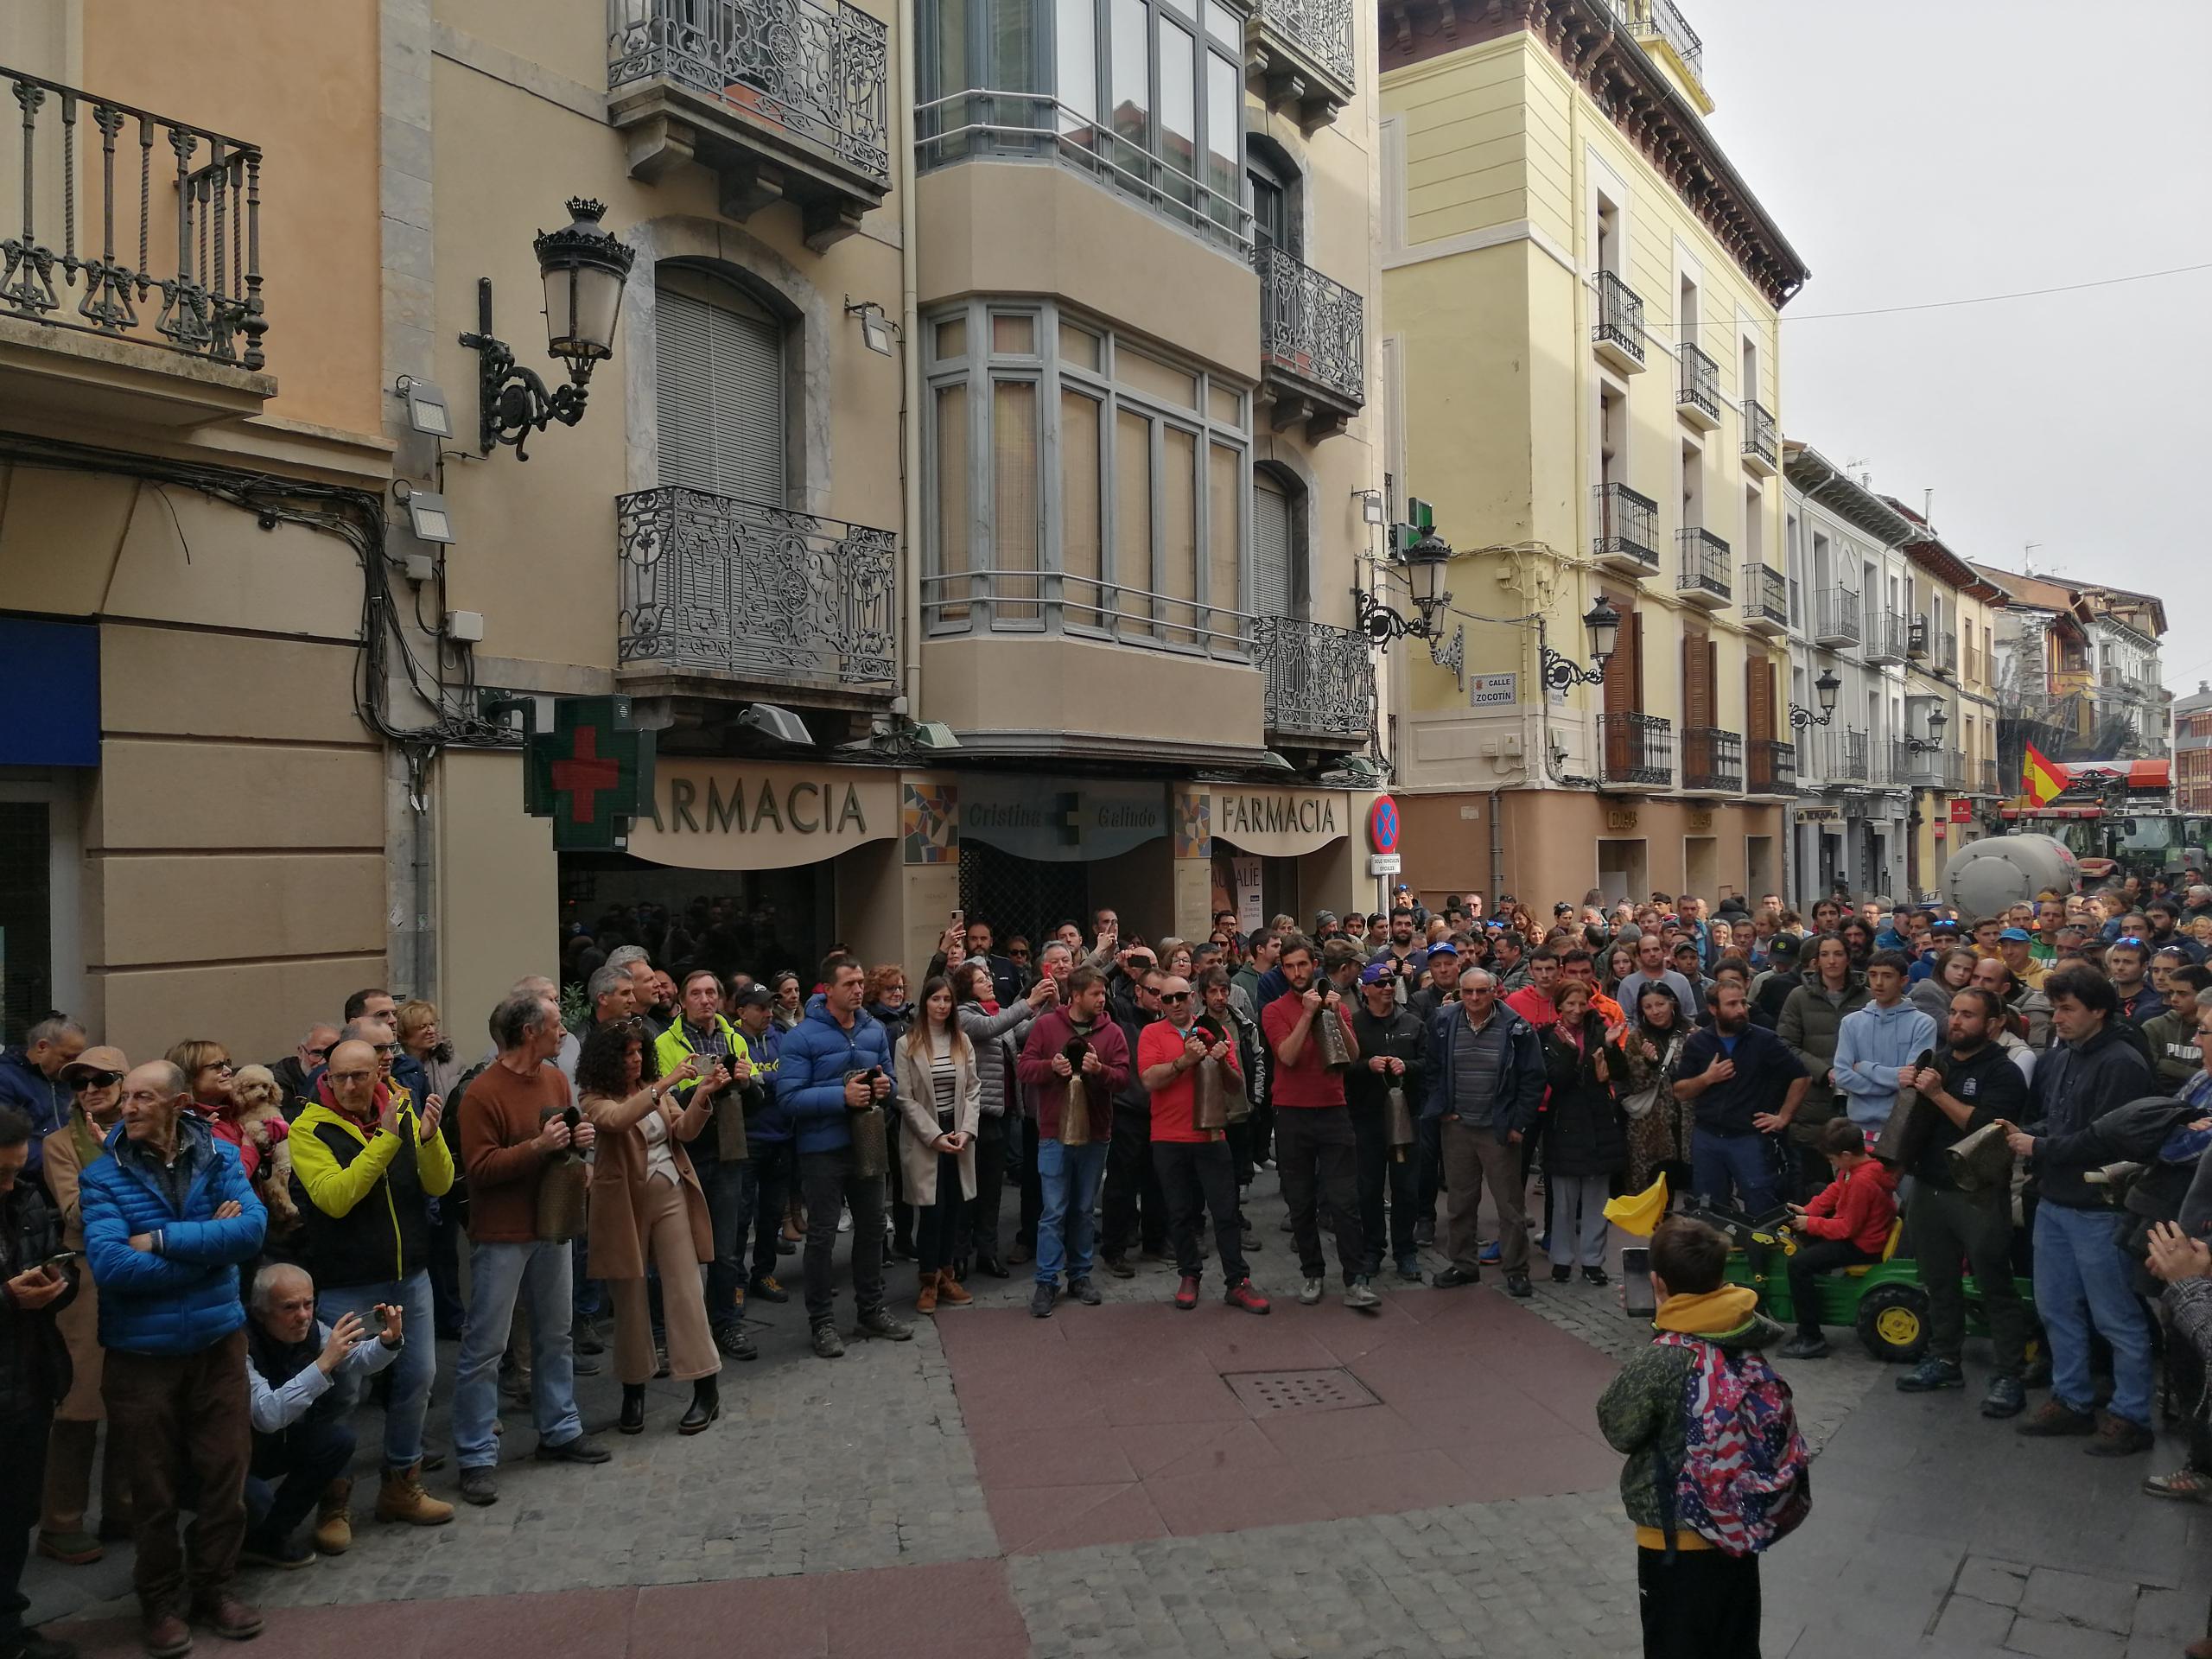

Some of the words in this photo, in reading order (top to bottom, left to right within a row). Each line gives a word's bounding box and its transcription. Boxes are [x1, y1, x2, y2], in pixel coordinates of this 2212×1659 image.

[1476, 690, 1511, 702] ZOCOTÍN
[1489, 678, 1510, 687] CALLE
[629, 777, 867, 833] RMACIA
[969, 802, 1042, 830] Cristina
[1098, 804, 1156, 829] Galindo
[1223, 796, 1336, 834] FARMACIA
